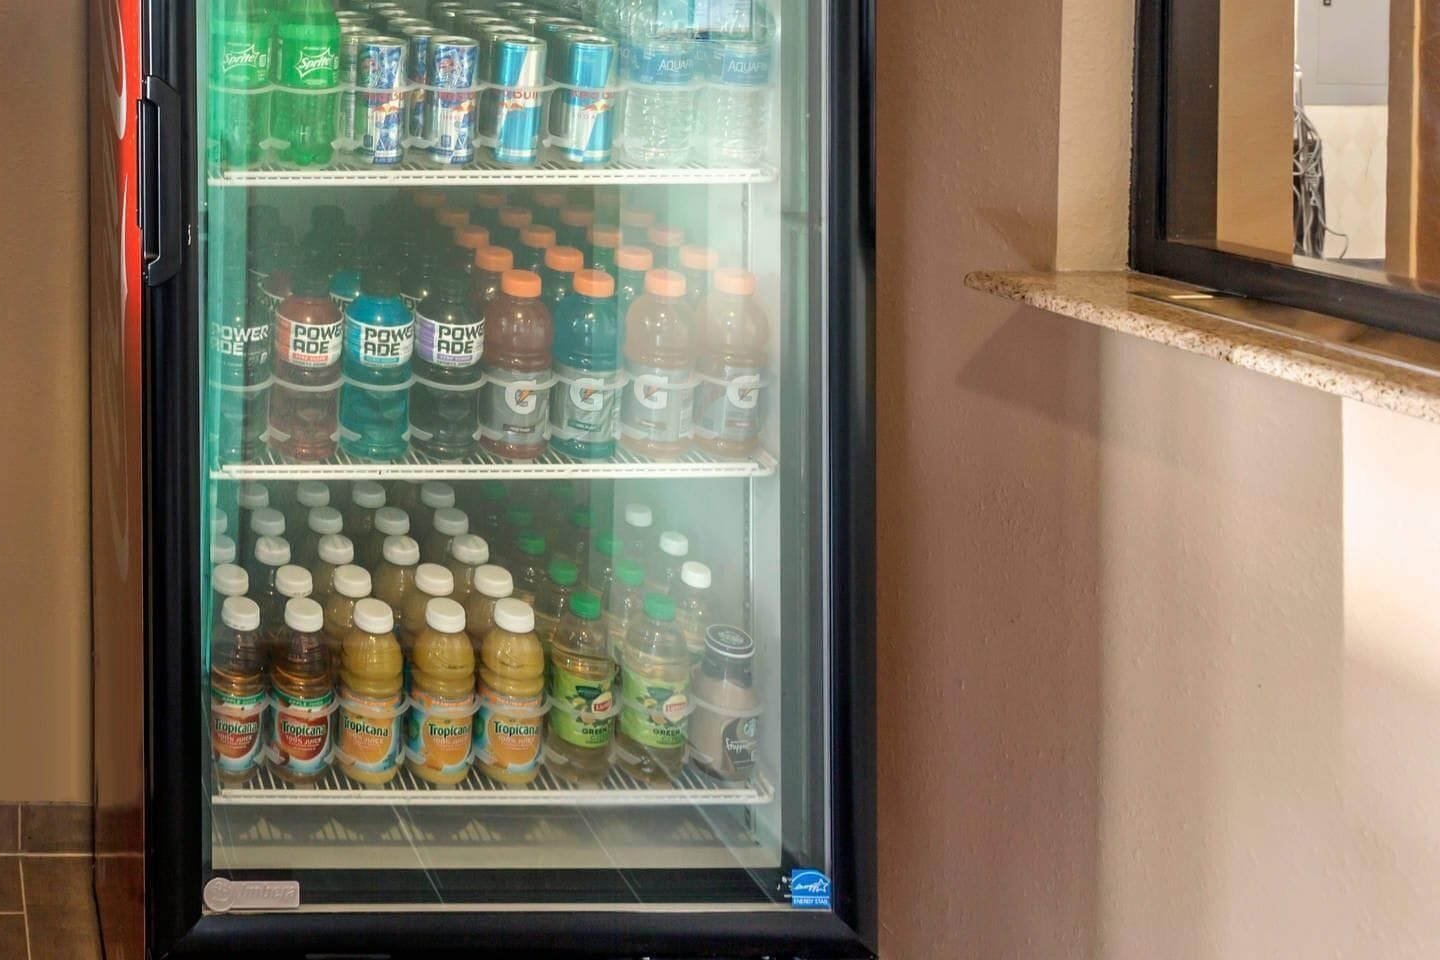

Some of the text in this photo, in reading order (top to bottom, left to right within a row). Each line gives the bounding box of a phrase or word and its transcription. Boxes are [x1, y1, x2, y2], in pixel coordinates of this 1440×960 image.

[364, 326, 414, 341] POWE
[294, 340, 330, 354] ADE
[364, 342, 401, 356] ADE
[436, 341, 474, 355] ADE
[215, 719, 258, 736] Tropicana
[344, 717, 389, 738] Tropicana
